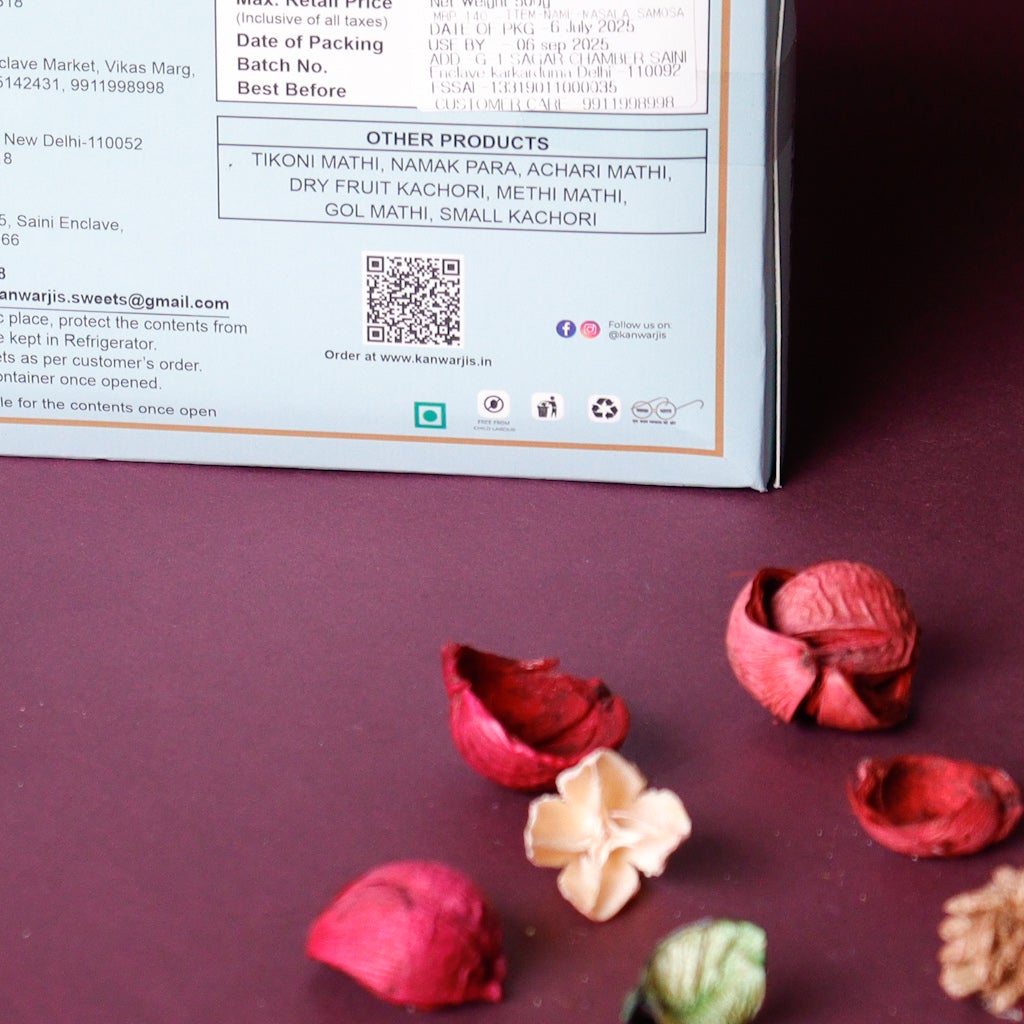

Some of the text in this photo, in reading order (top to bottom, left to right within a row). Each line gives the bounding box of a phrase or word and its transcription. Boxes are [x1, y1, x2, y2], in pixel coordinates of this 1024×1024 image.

[236, 11, 388, 31] (Inclusive of all taxes)
[598, 19, 635, 33] 2025
[236, 32, 383, 55] Date of Packing
[572, 37, 609, 51] 2025
[42, 57, 100, 75] Market,
[104, 59, 147, 74] Vikas
[151, 60, 195, 79] Marg,
[237, 56, 327, 74] Batch No.
[237, 80, 347, 98] Best Before
[366, 130, 549, 151] OTHER PRODUCTS
[251, 151, 672, 182] TIKONI MATHI, NAMAK PARA, ACHARI MATHI,
[289, 177, 627, 206] DRY FRUIT KACHORI, METHI MATHI,
[324, 202, 597, 227] GOL MATHI, SMALL KACHORI
[8, 310, 53, 329] place,
[58, 314, 111, 330] protect
[114, 315, 139, 330] the
[143, 317, 209, 333] contents
[212, 319, 248, 335] from
[324, 349, 492, 368] Order at www.kanwarjis.in
[16, 396, 38, 409] for
[41, 397, 65, 410] the
[70, 400, 134, 414] contents
[138, 404, 175, 415] once
[179, 407, 217, 419] open
